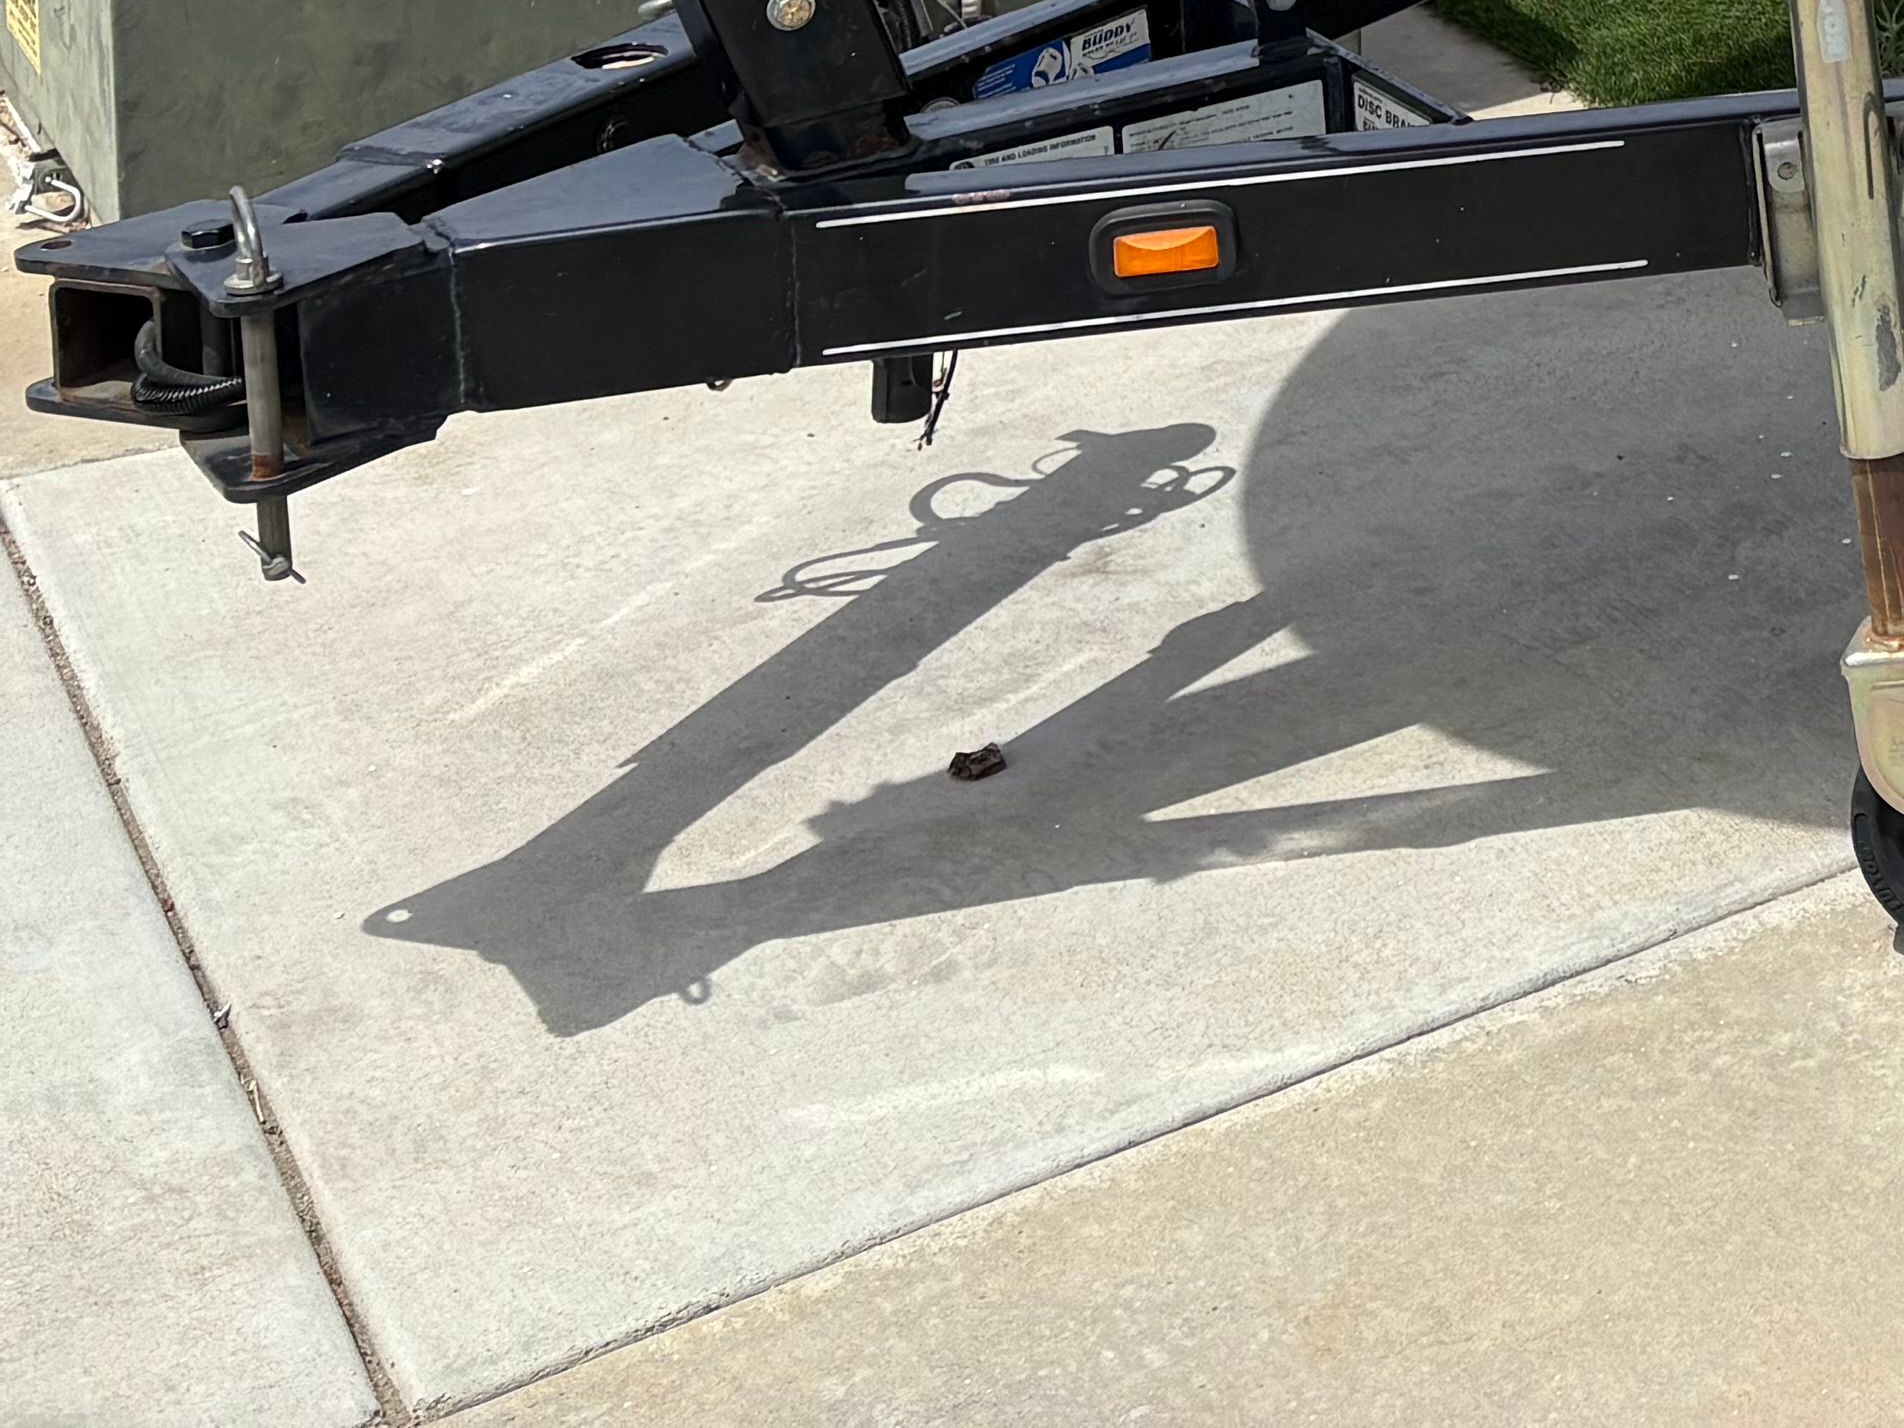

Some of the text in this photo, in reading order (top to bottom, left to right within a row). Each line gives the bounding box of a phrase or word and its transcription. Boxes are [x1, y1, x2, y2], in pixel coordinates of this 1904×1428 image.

[1081, 20, 1135, 51] BUDDY
[1358, 94, 1382, 119] DISC
[1001, 152, 1017, 162] AND
